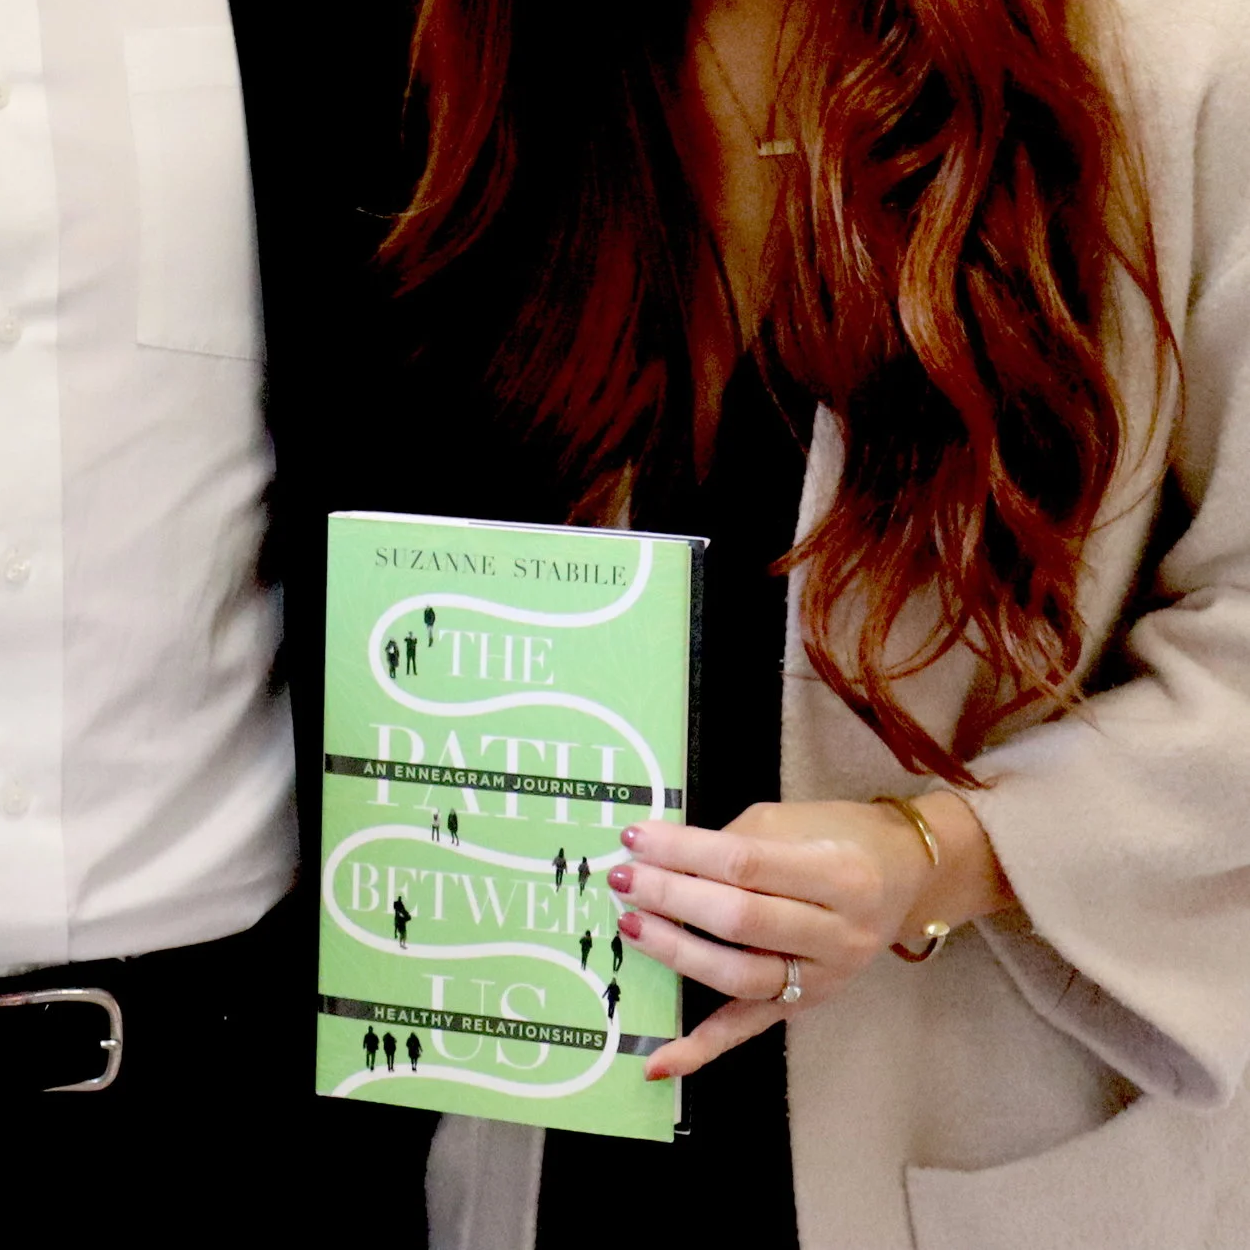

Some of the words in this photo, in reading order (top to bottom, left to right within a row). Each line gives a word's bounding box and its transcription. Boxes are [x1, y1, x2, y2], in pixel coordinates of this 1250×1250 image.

[374, 547, 496, 577] SUZANNE
[513, 558, 627, 587] STABILE
[438, 629, 554, 685] THE
[363, 763, 387, 777] AN
[394, 765, 506, 789] ENNEAGRAM
[512, 777, 599, 798] JOURNEY
[607, 785, 631, 800] TO
[366, 723, 626, 829] PATH
[374, 1006, 454, 1028] HEALTHY
[461, 1018, 604, 1047] RELATIONSHIPS
[422, 974, 550, 1070] US
